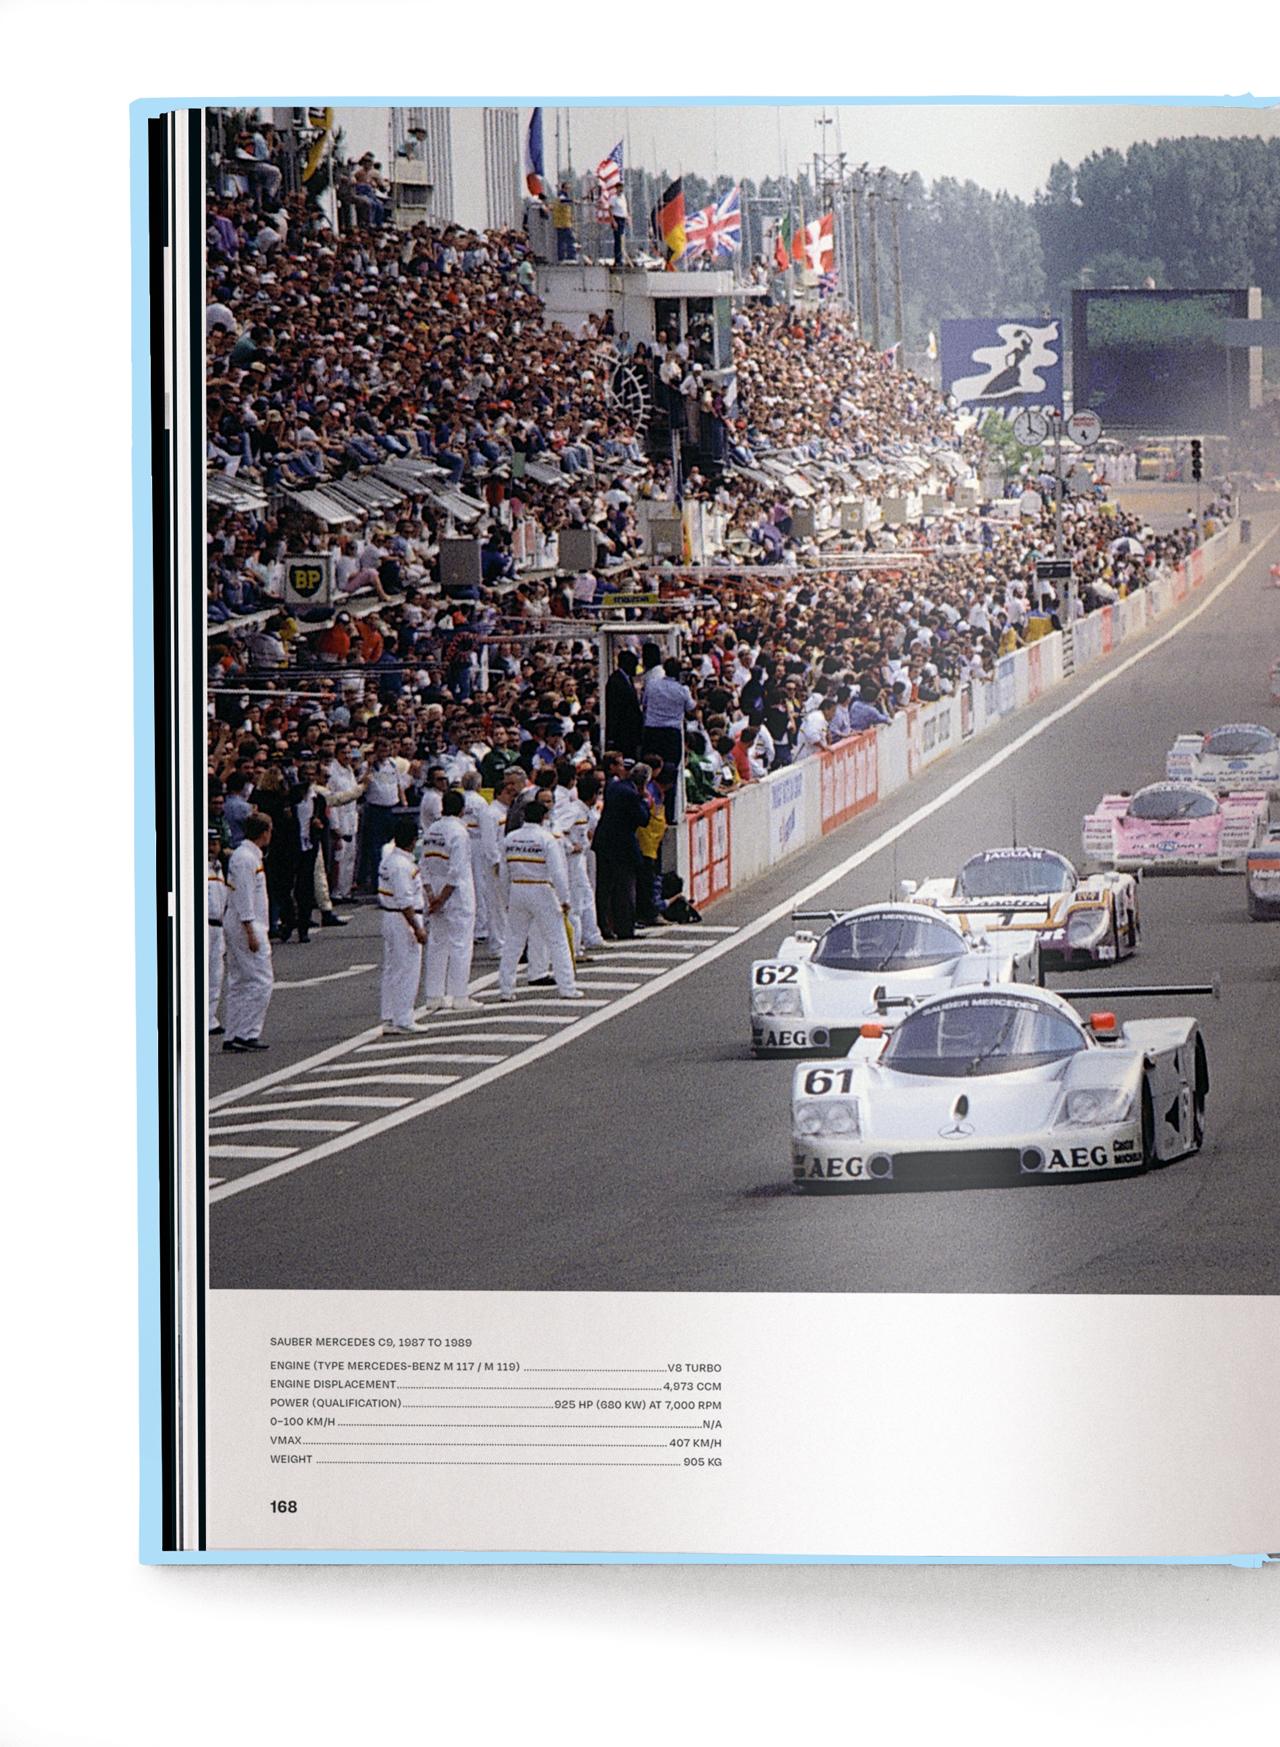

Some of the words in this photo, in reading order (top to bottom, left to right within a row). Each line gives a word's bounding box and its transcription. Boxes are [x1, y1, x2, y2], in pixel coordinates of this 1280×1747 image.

[294, 569, 321, 590] BP
[984, 851, 1043, 862] JAGUAR
[755, 964, 799, 986] 62
[972, 998, 1040, 1012] MERCEDES
[766, 1030, 808, 1047] AEG
[803, 1068, 854, 1096] 61
[1047, 1145, 1108, 1170] AEG
[807, 1156, 863, 1178] AEG
[269, 1336, 313, 1347] SAUBER
[315, 1337, 376, 1347] MERCEDES
[377, 1337, 396, 1349] C9,
[398, 1337, 426, 1348] 1987
[427, 1338, 442, 1348] TO
[445, 1338, 473, 1348] 1989
[270, 1360, 311, 1371] ENGINE
[313, 1359, 345, 1371] (TYPE
[347, 1361, 441, 1372] MERCEDES-BENZ
[443, 1361, 454, 1371] M
[456, 1361, 475, 1372] 117
[484, 1361, 494, 1372] M
[497, 1361, 521, 1373] 119)
[667, 1363, 683, 1373] V8
[684, 1363, 722, 1373] TURBO
[270, 1379, 311, 1389] ENGINE
[313, 1379, 397, 1389] DISPLACEMENT
[662, 1381, 694, 1392] 4,973
[696, 1382, 722, 1391] CCM
[270, 1398, 309, 1408] POWER
[312, 1397, 403, 1409] (QUALIFICATION)
[554, 1399, 576, 1409] 925
[578, 1400, 594, 1409] HP
[596, 1399, 622, 1410] (680
[624, 1399, 647, 1411] KW)
[648, 1400, 662, 1410] AT
[665, 1400, 696, 1411] 7,000
[698, 1400, 722, 1410] RPM
[306, 1417, 336, 1428] KM/H
[702, 1419, 723, 1430] N/A
[269, 1435, 302, 1445] VMAX
[669, 1438, 691, 1448] 407
[693, 1438, 722, 1449] KM/H
[270, 1454, 313, 1464] WEIGHT
[683, 1457, 705, 1467] 905
[707, 1457, 722, 1467] KG
[269, 1499, 299, 1514] 168
